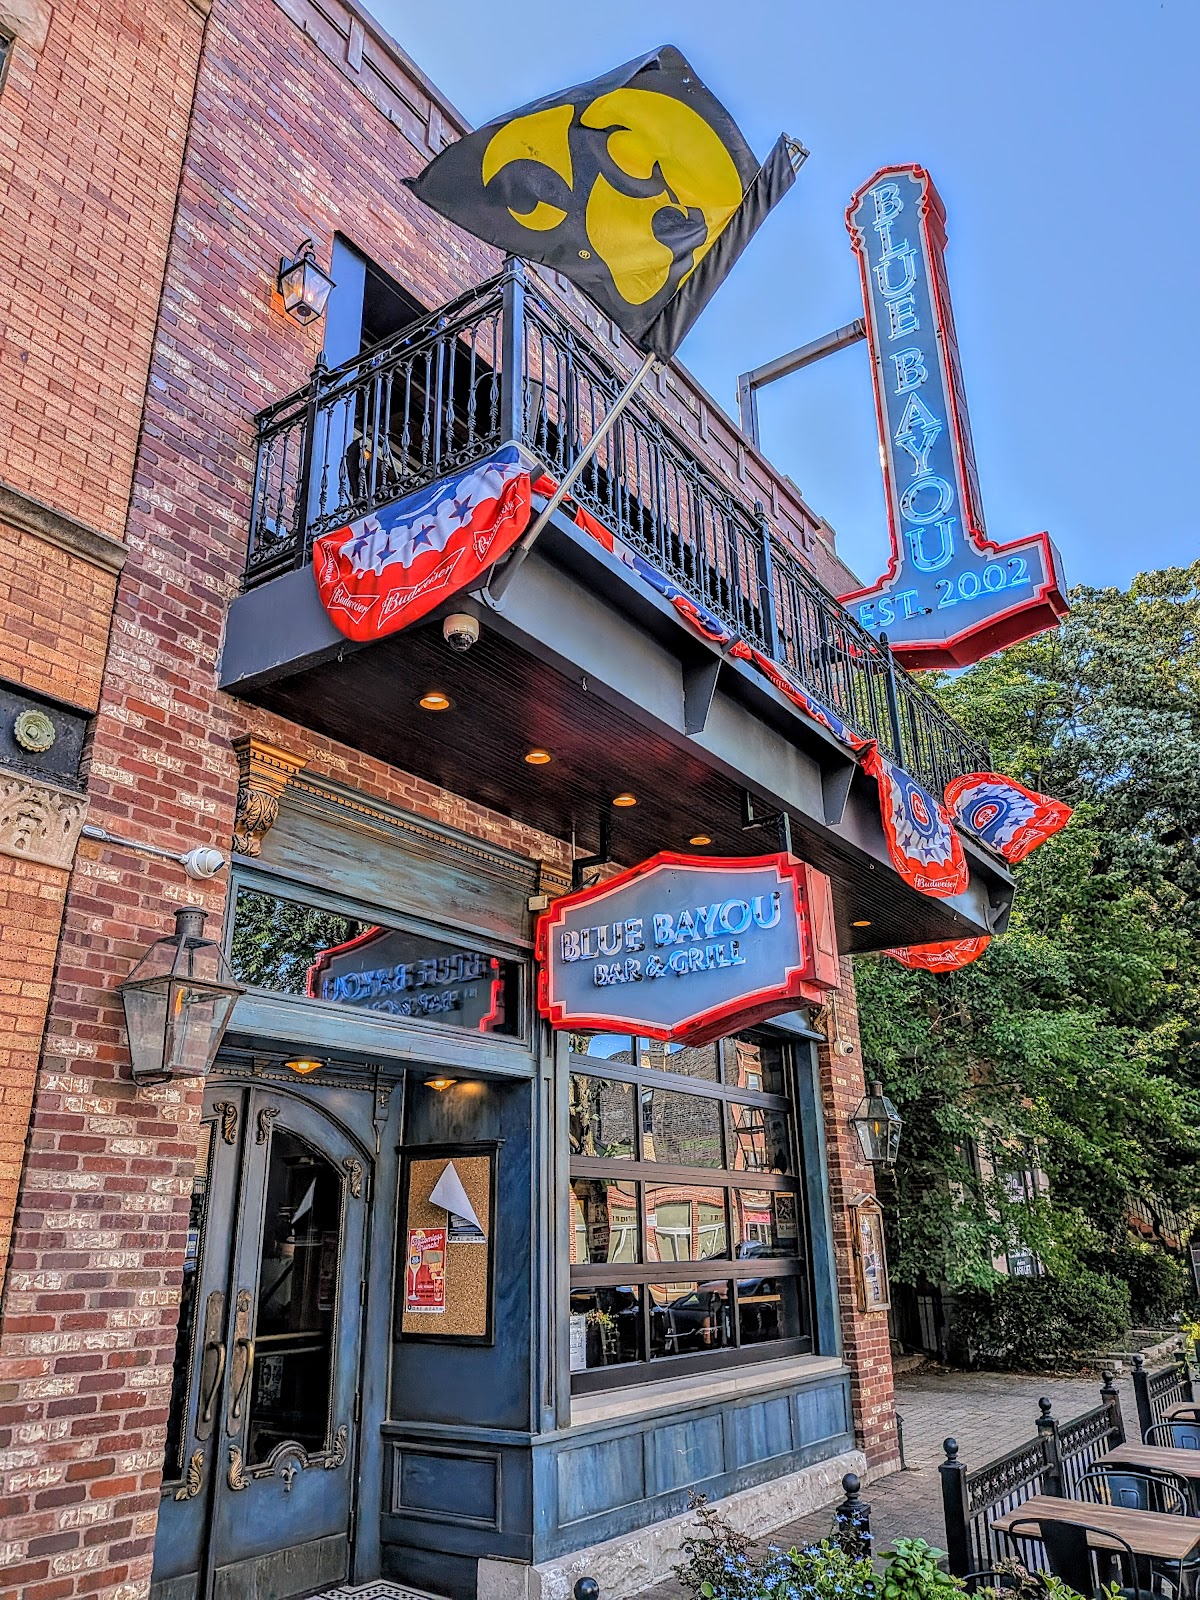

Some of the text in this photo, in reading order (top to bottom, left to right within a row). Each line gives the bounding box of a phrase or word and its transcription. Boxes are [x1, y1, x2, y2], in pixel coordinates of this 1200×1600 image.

[868, 182, 956, 572] BLUE BAYOU
[333, 587, 369, 613] Budweiser
[382, 562, 454, 614] Budweiser
[858, 557, 1031, 630] EST. 2002
[914, 876, 956, 889] Budweiser
[560, 892, 782, 963] BLUE BAYOU
[593, 940, 747, 987] BAR & GRILL
